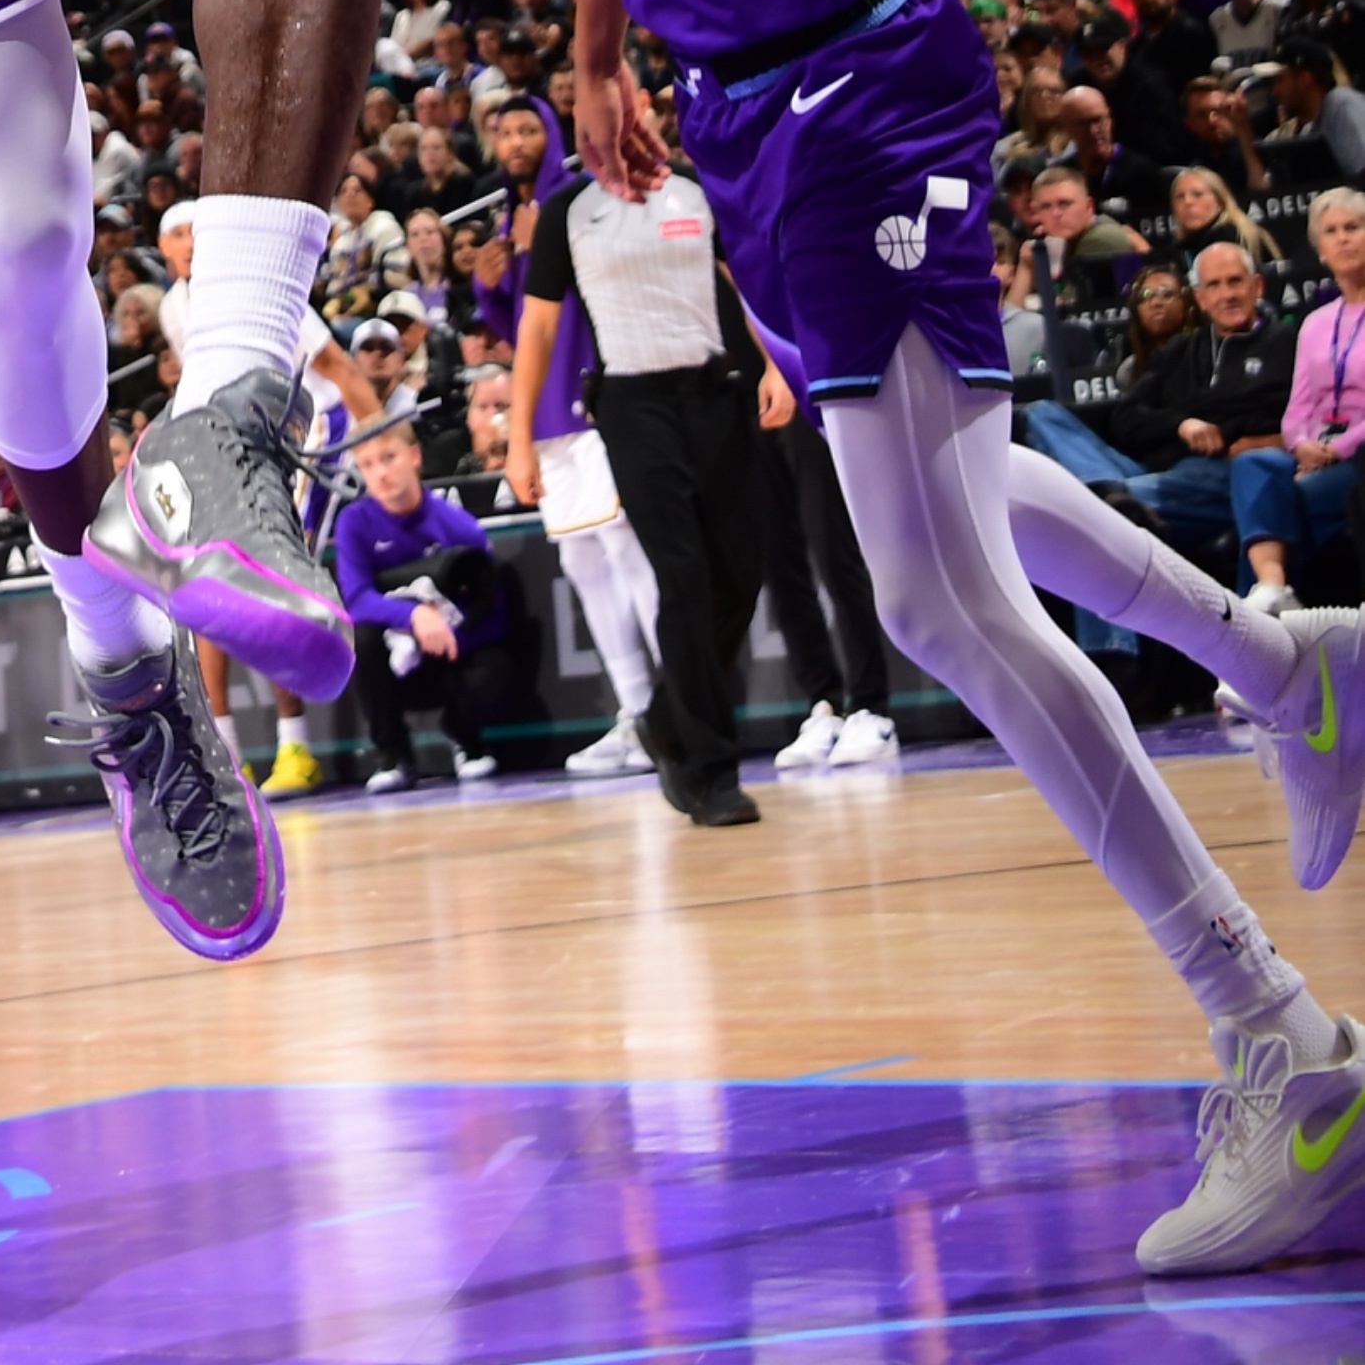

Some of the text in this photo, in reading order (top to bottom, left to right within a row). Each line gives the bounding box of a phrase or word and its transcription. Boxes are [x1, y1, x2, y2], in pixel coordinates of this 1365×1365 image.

[1265, 191, 1318, 218] DELT
[1139, 215, 1178, 236] DEL
[1073, 376, 1121, 404] DEL
